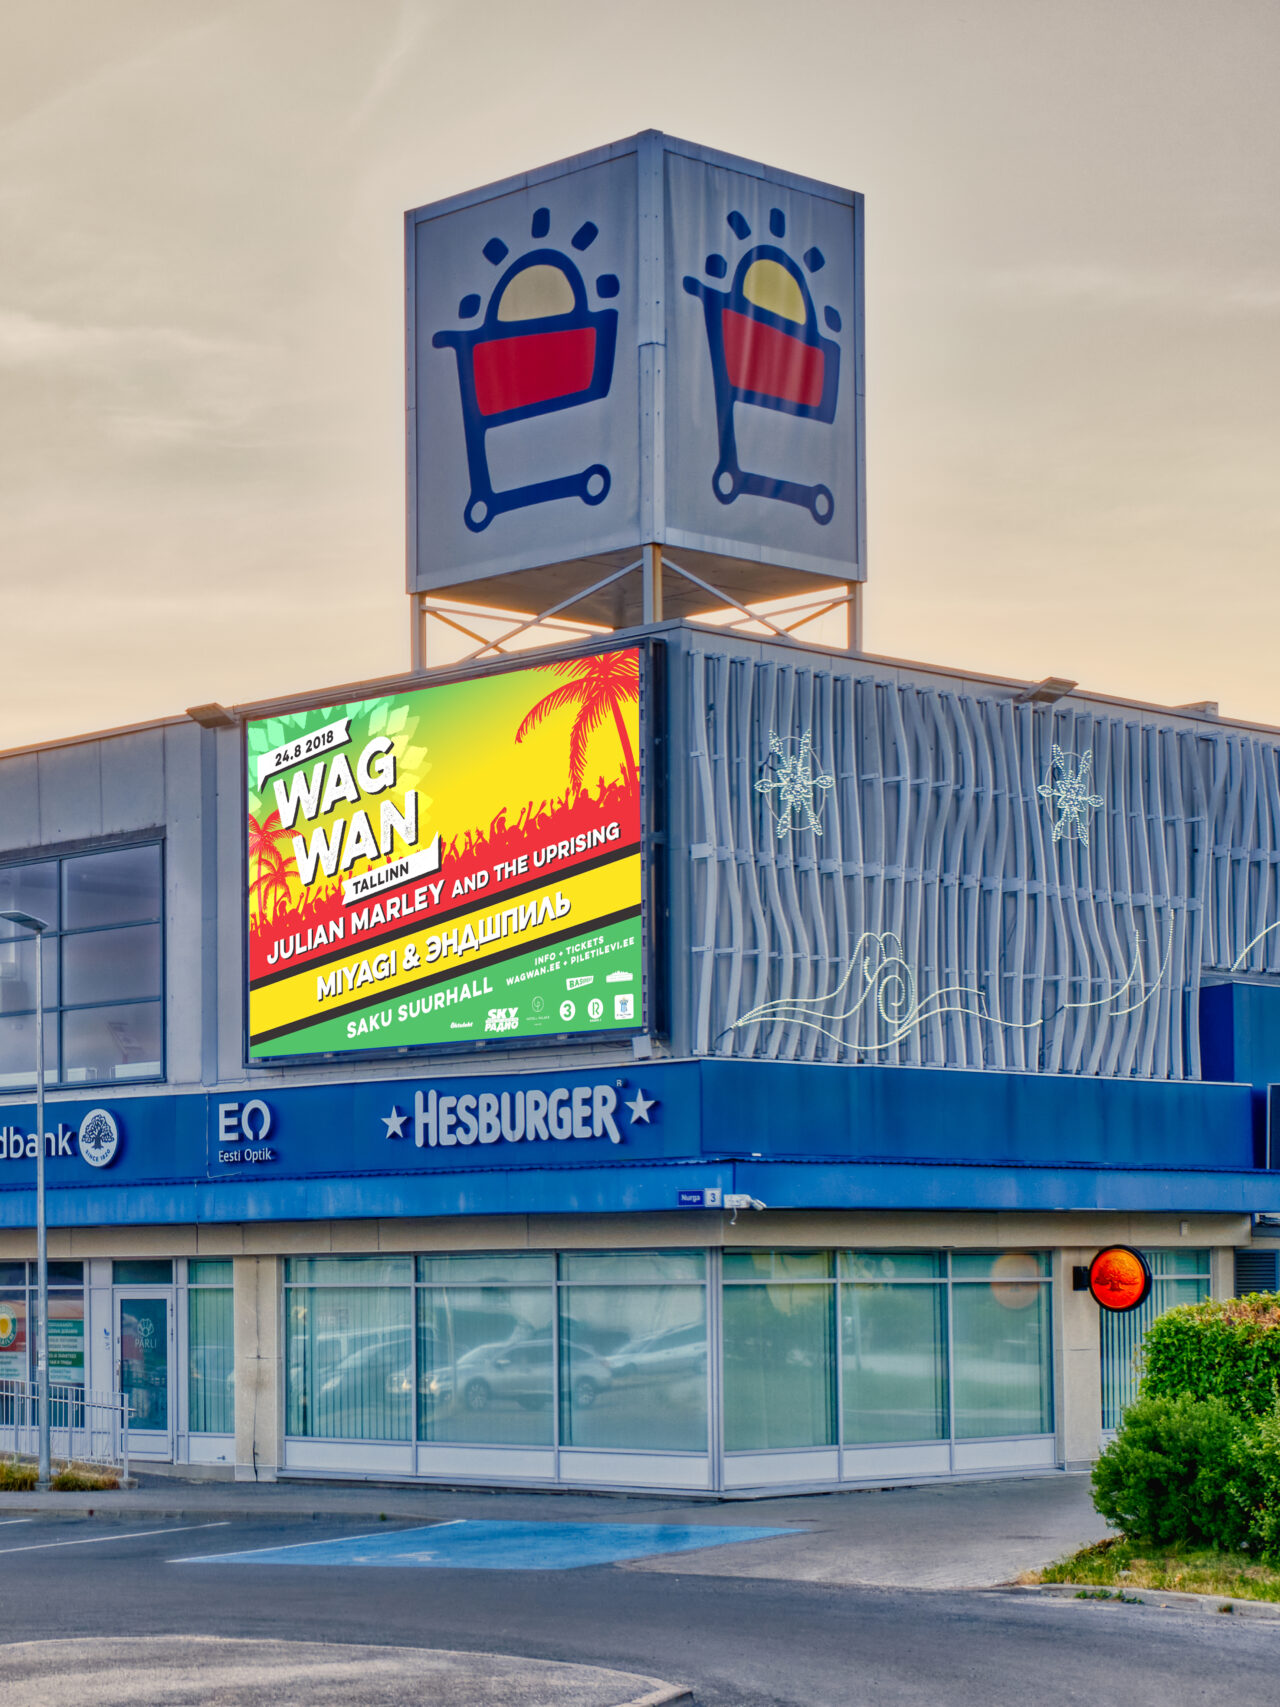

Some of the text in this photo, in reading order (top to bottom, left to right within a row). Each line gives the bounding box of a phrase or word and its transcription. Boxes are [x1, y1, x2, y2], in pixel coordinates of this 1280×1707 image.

[275, 730, 334, 767] 24.8 2018
[273, 736, 397, 830] WAG
[292, 789, 418, 887] WAN
[266, 821, 622, 965] JULIAN MARLEY AND THE UPRISING
[352, 861, 409, 895] TALLINN
[316, 891, 572, 1002] MIYAGI & ЭНДШПИЛЬ
[506, 961, 561, 986] WAGWAN.EE
[570, 936, 635, 965] PILETILEVI.EE
[534, 936, 604, 966] INFO TICKETS
[347, 977, 495, 1040] SAKU SUURHALL
[487, 1007, 519, 1020] SKY
[218, 1099, 271, 1141] EO
[414, 1084, 621, 1148] HESBURGER
[85, 1149, 99, 1162] SINCE
[218, 1147, 272, 1164] Eesti Optik
[681, 1192, 716, 1203] Nurga 3
